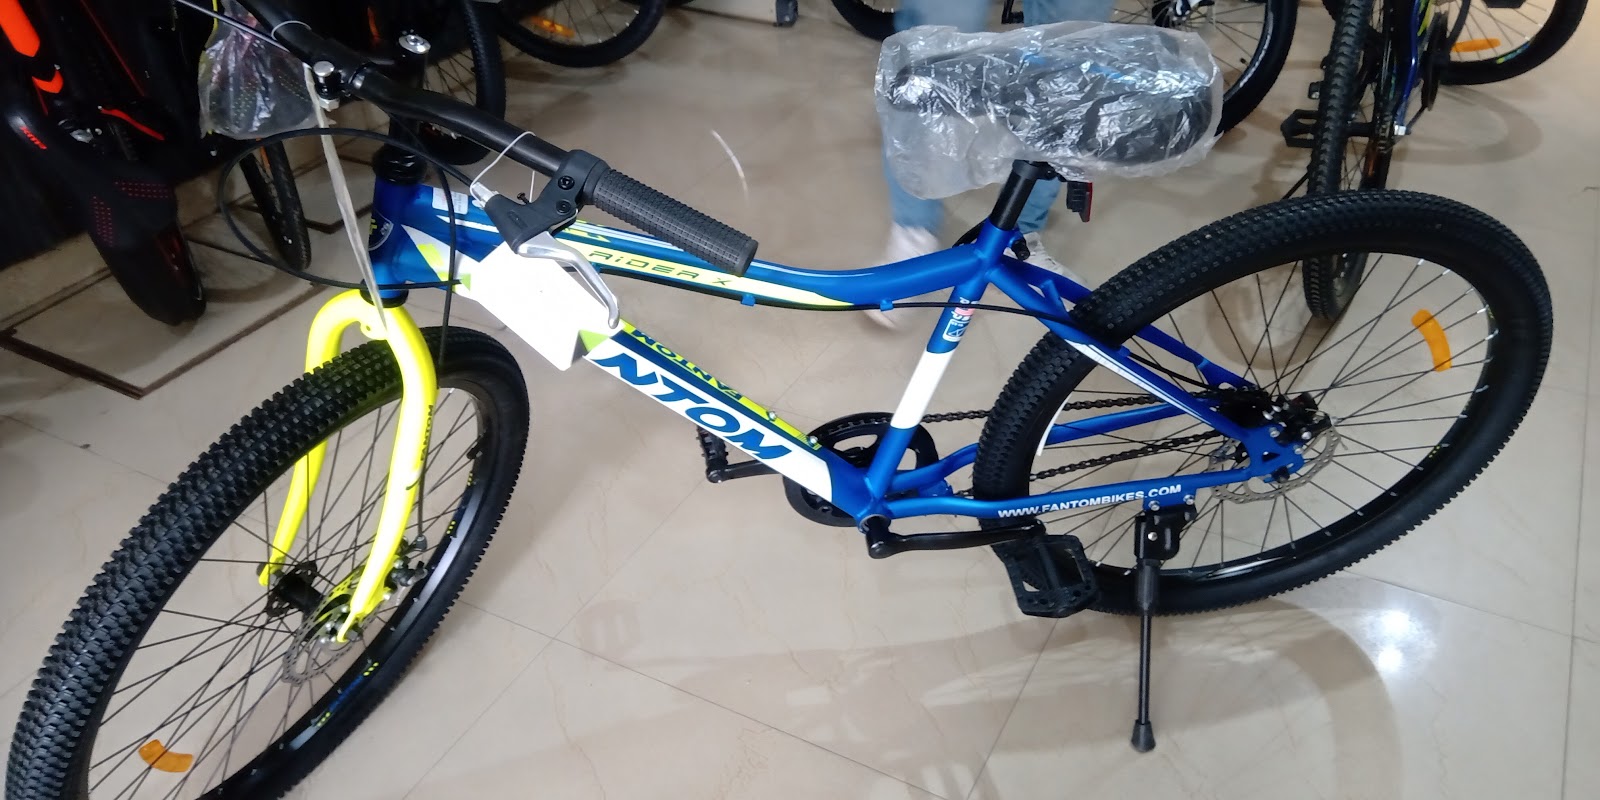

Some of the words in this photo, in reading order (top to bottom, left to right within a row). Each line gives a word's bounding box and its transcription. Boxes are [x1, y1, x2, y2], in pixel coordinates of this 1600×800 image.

[712, 278, 732, 286] X
[631, 329, 743, 400] FANTOM
[997, 484, 1182, 518] WWW.FANTOMBIKES.COM
